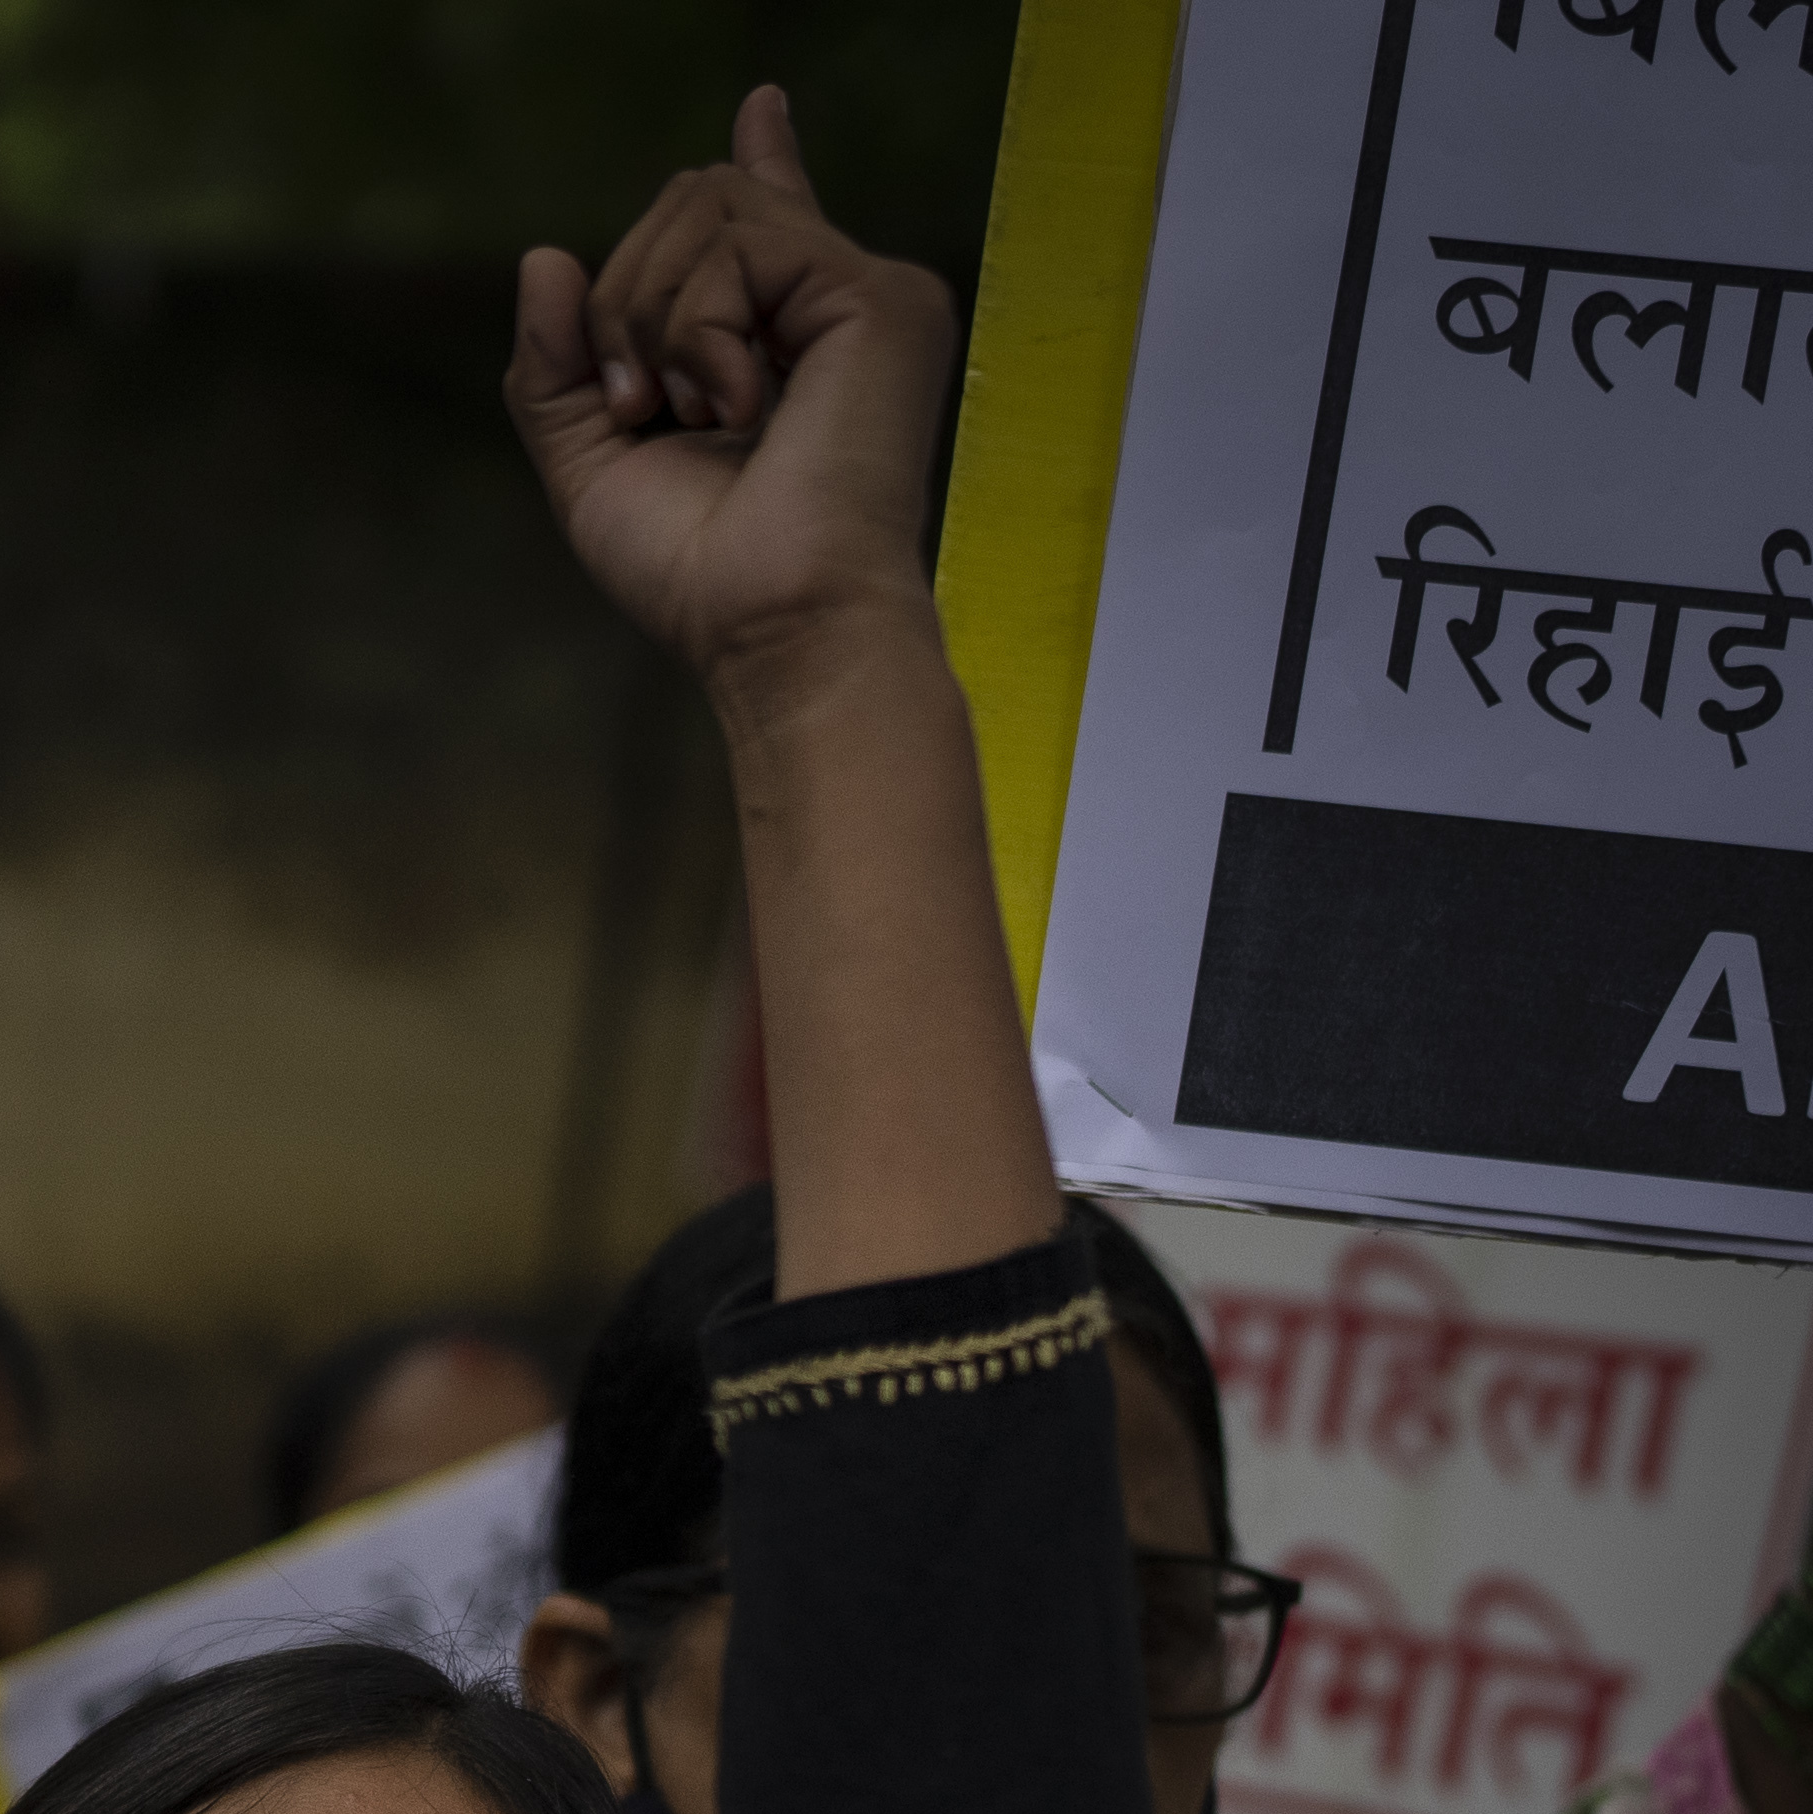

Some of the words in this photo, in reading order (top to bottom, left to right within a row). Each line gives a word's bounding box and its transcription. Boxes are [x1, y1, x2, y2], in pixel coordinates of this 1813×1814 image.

[1430, 236, 1813, 404] बला
[1623, 930, 1813, 1120] A
[1201, 1235, 1706, 1505] महिला
[1218, 1540, 1638, 1795] मिति
